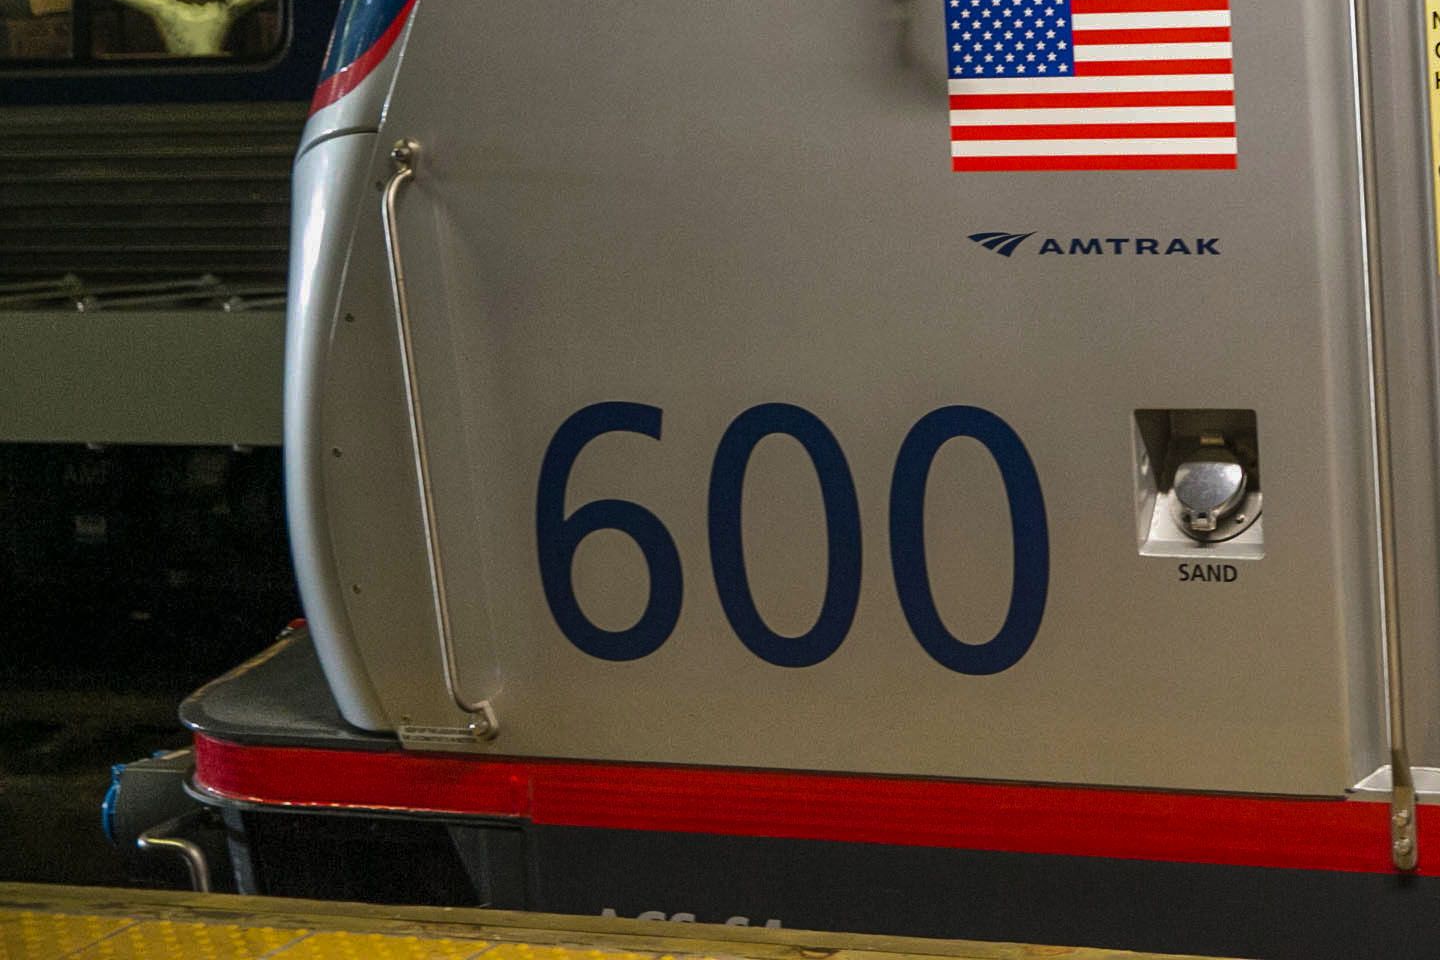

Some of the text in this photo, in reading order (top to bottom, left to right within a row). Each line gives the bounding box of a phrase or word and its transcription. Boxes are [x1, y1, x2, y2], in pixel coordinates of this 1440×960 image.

[1038, 237, 1222, 256] AMTRAK
[536, 401, 1051, 677] 600
[1177, 562, 1239, 583] SAND
